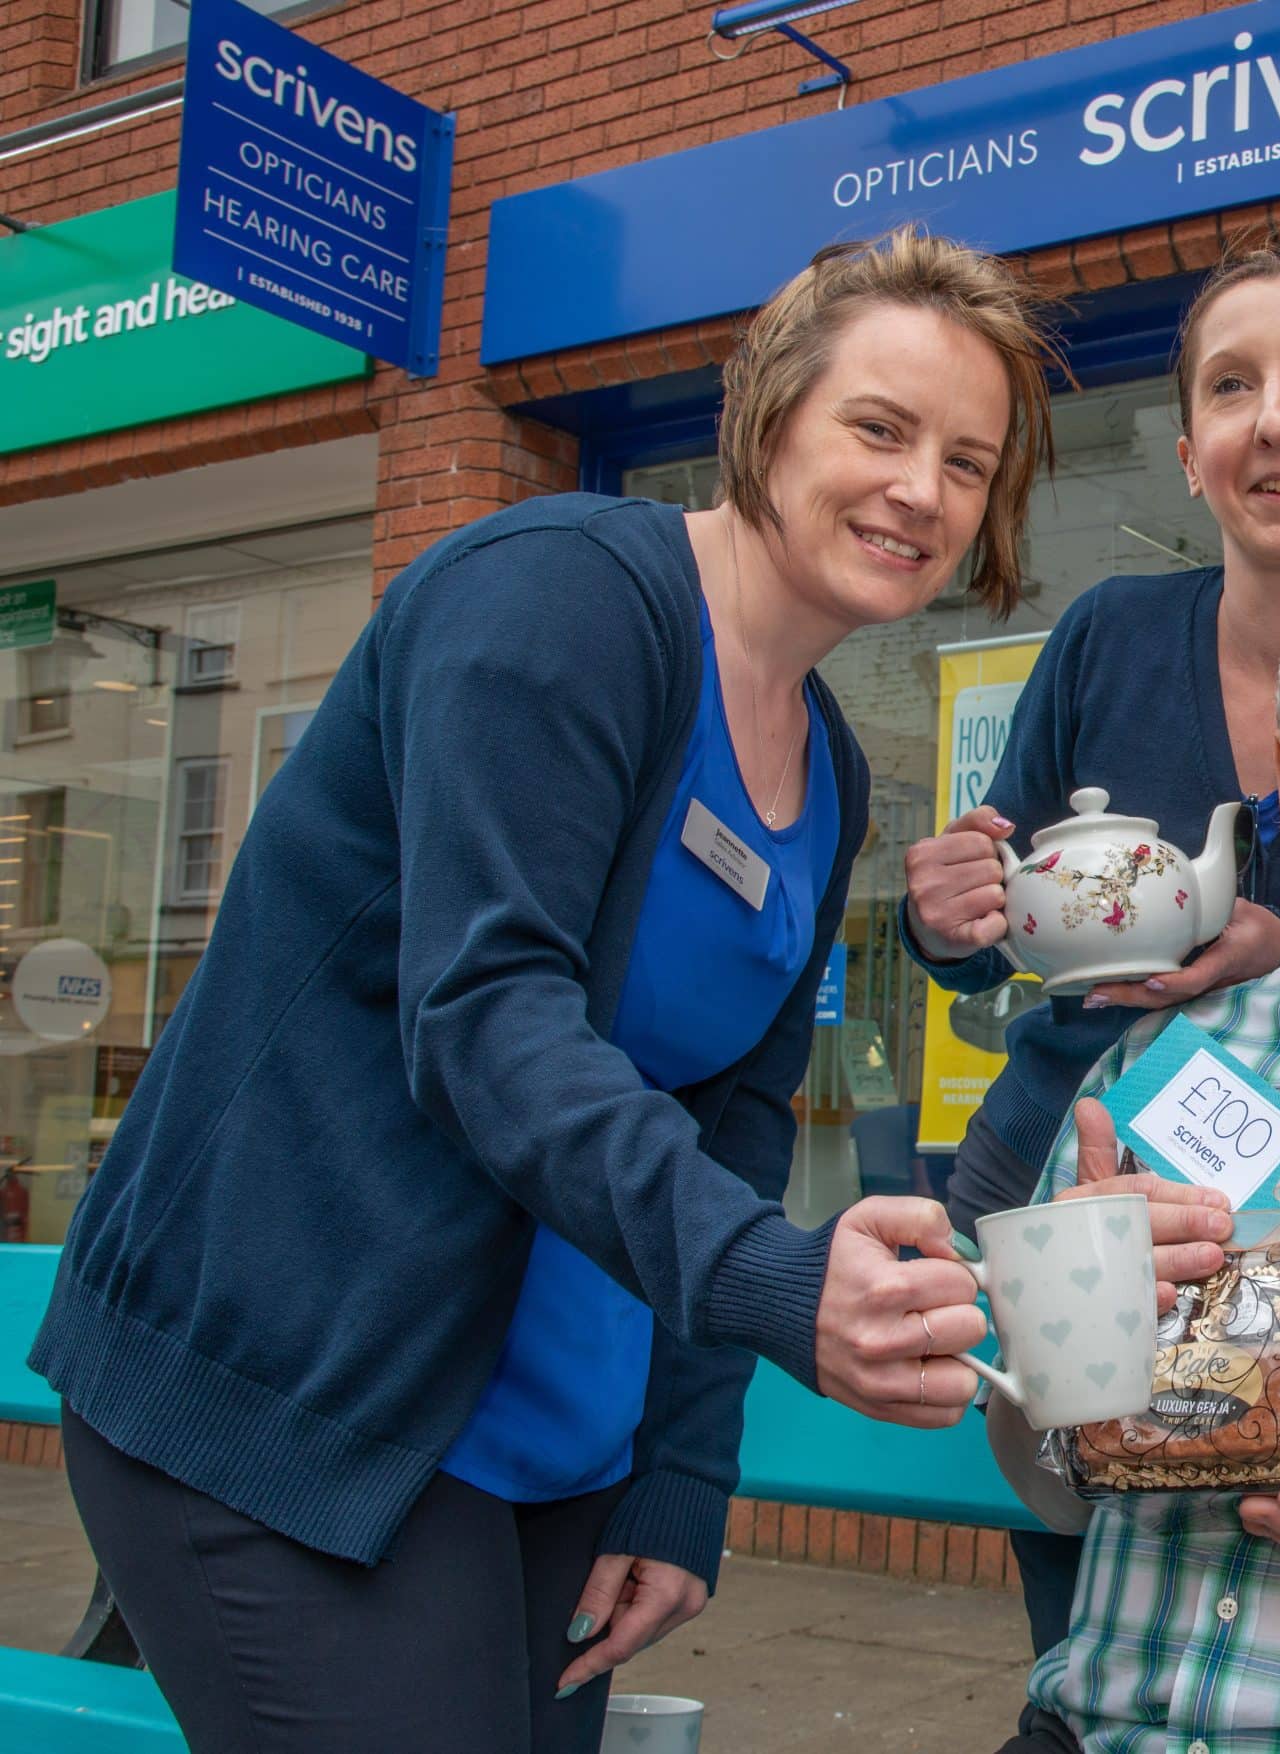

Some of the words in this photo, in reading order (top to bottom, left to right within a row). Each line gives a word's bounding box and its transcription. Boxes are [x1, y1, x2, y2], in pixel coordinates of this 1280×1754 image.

[215, 39, 417, 172] scrivens
[239, 142, 386, 231] OPTICIANS
[833, 129, 1038, 207] OPTICIANS
[204, 188, 332, 267] HEARING
[341, 254, 409, 302] CARE
[6, 306, 90, 363] sight
[94, 282, 160, 338] and
[164, 278, 237, 321] hea
[249, 273, 332, 317] ESTABLISHED
[334, 310, 363, 331] 1938
[958, 712, 1014, 764] HOW
[955, 770, 982, 818] IS
[708, 849, 744, 885] scrivens
[60, 977, 100, 995] NHS
[1178, 1077, 1273, 1159] £100
[1173, 1124, 1226, 1173] scrivens
[1154, 1348, 1231, 1378] Cake
[1156, 1400, 1195, 1413] LUXURY
